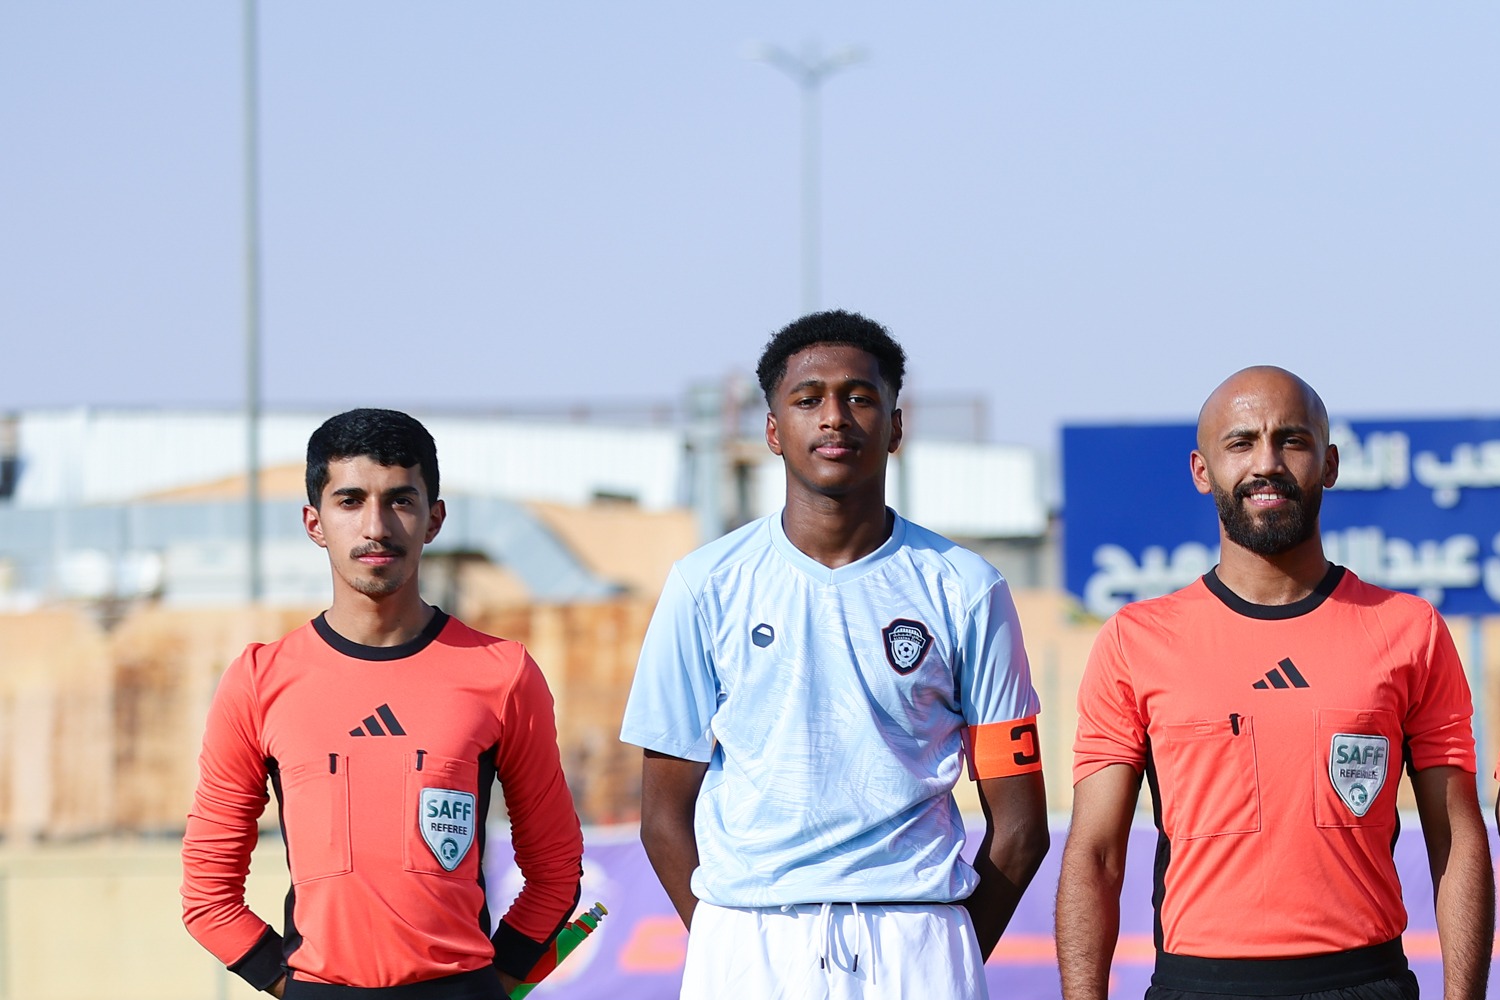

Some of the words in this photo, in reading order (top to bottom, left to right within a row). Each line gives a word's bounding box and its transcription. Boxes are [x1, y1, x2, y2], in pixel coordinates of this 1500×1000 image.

[1336, 744, 1385, 766] SAFF
[426, 798, 472, 822] SAFF
[430, 822, 468, 836] REFEREE
